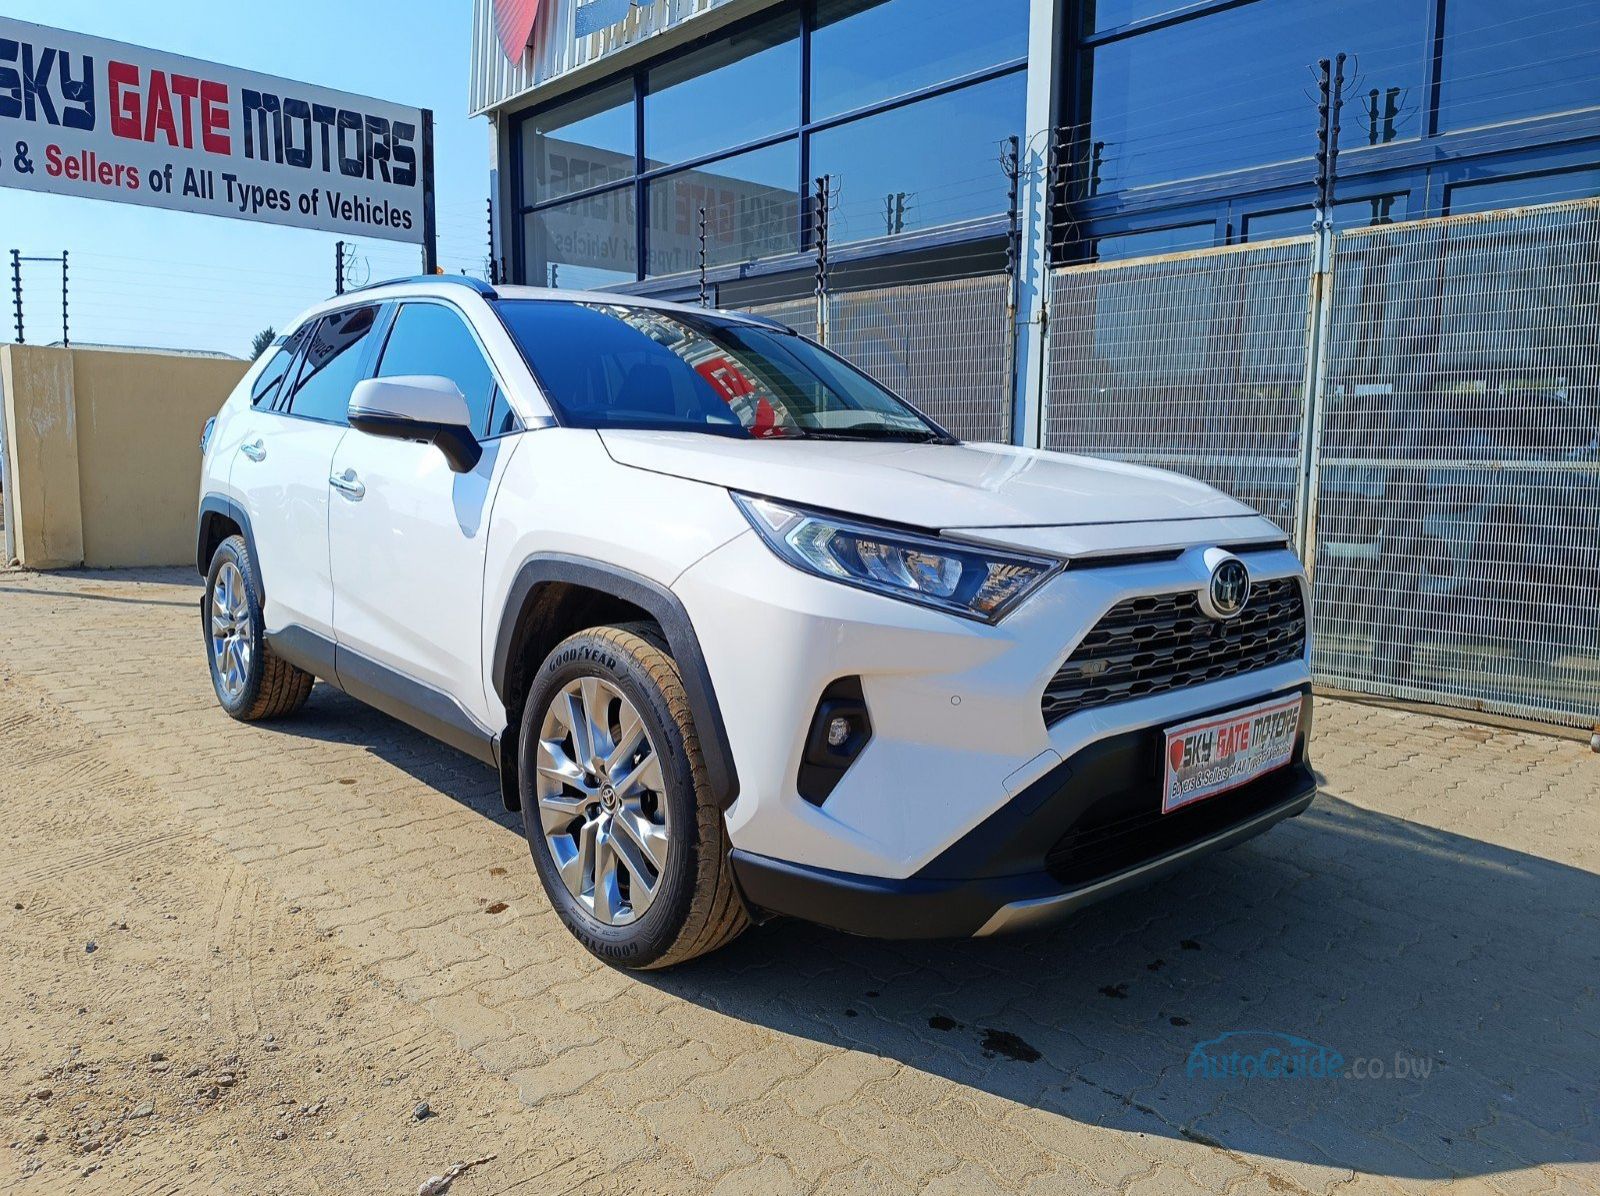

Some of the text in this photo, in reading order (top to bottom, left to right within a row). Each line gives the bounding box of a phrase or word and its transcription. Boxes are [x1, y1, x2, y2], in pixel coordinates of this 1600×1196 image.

[0, 37, 417, 188] SKY GATE MOTORS
[14, 140, 34, 174] &
[45, 143, 140, 190] Sellers
[148, 163, 173, 194] of
[182, 167, 214, 200] All
[222, 173, 291, 215] Types
[298, 188, 319, 217] of
[326, 190, 413, 230] Vehicles
[549, 646, 617, 673] GOODYEAR
[1182, 706, 1299, 768] SKY GATE MOTORS
[1171, 776, 1195, 799] Buyers
[1196, 772, 1205, 789] &
[1204, 764, 1230, 785] Sellers
[1228, 762, 1237, 777] of
[1236, 757, 1247, 774] All
[567, 922, 639, 958] GOODYEAR
